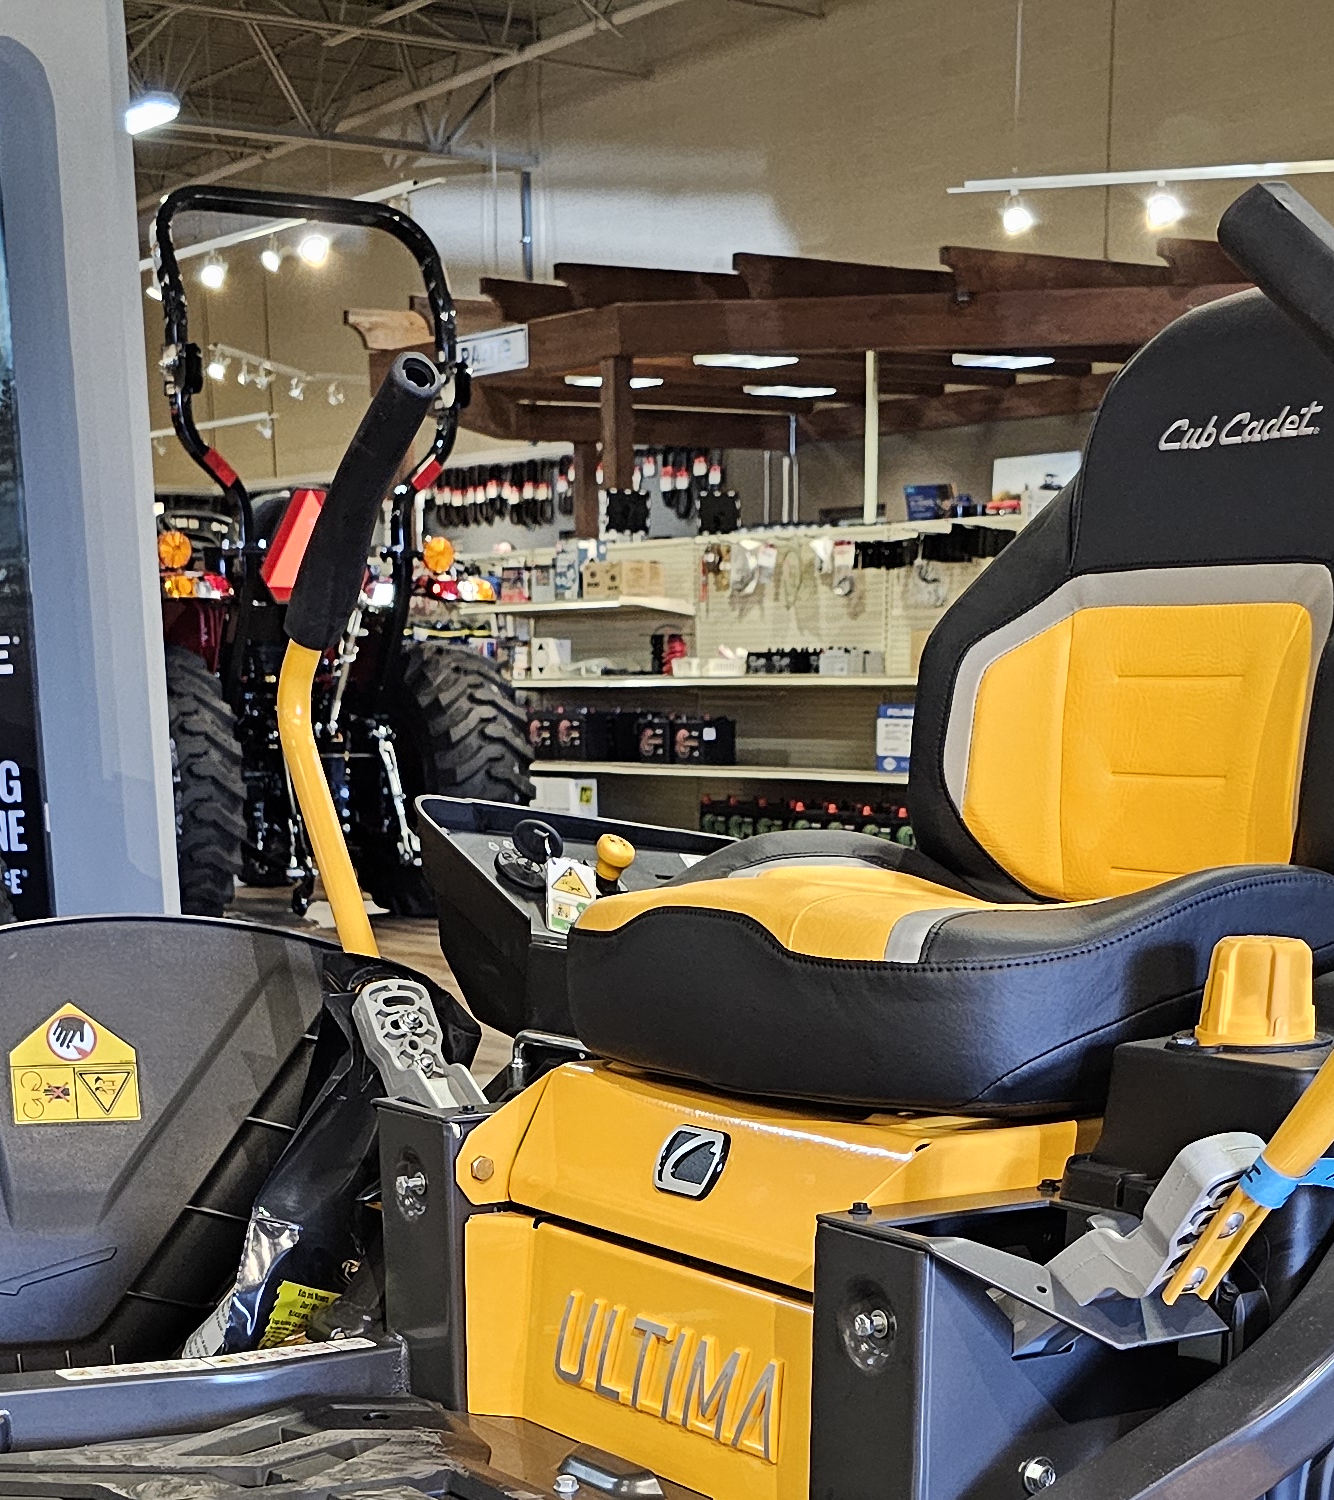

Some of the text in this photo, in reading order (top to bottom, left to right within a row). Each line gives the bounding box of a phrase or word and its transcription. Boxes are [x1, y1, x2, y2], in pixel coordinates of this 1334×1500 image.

[1158, 400, 1324, 451] Cub Cadet
[555, 1289, 785, 1465] ULTIMA
